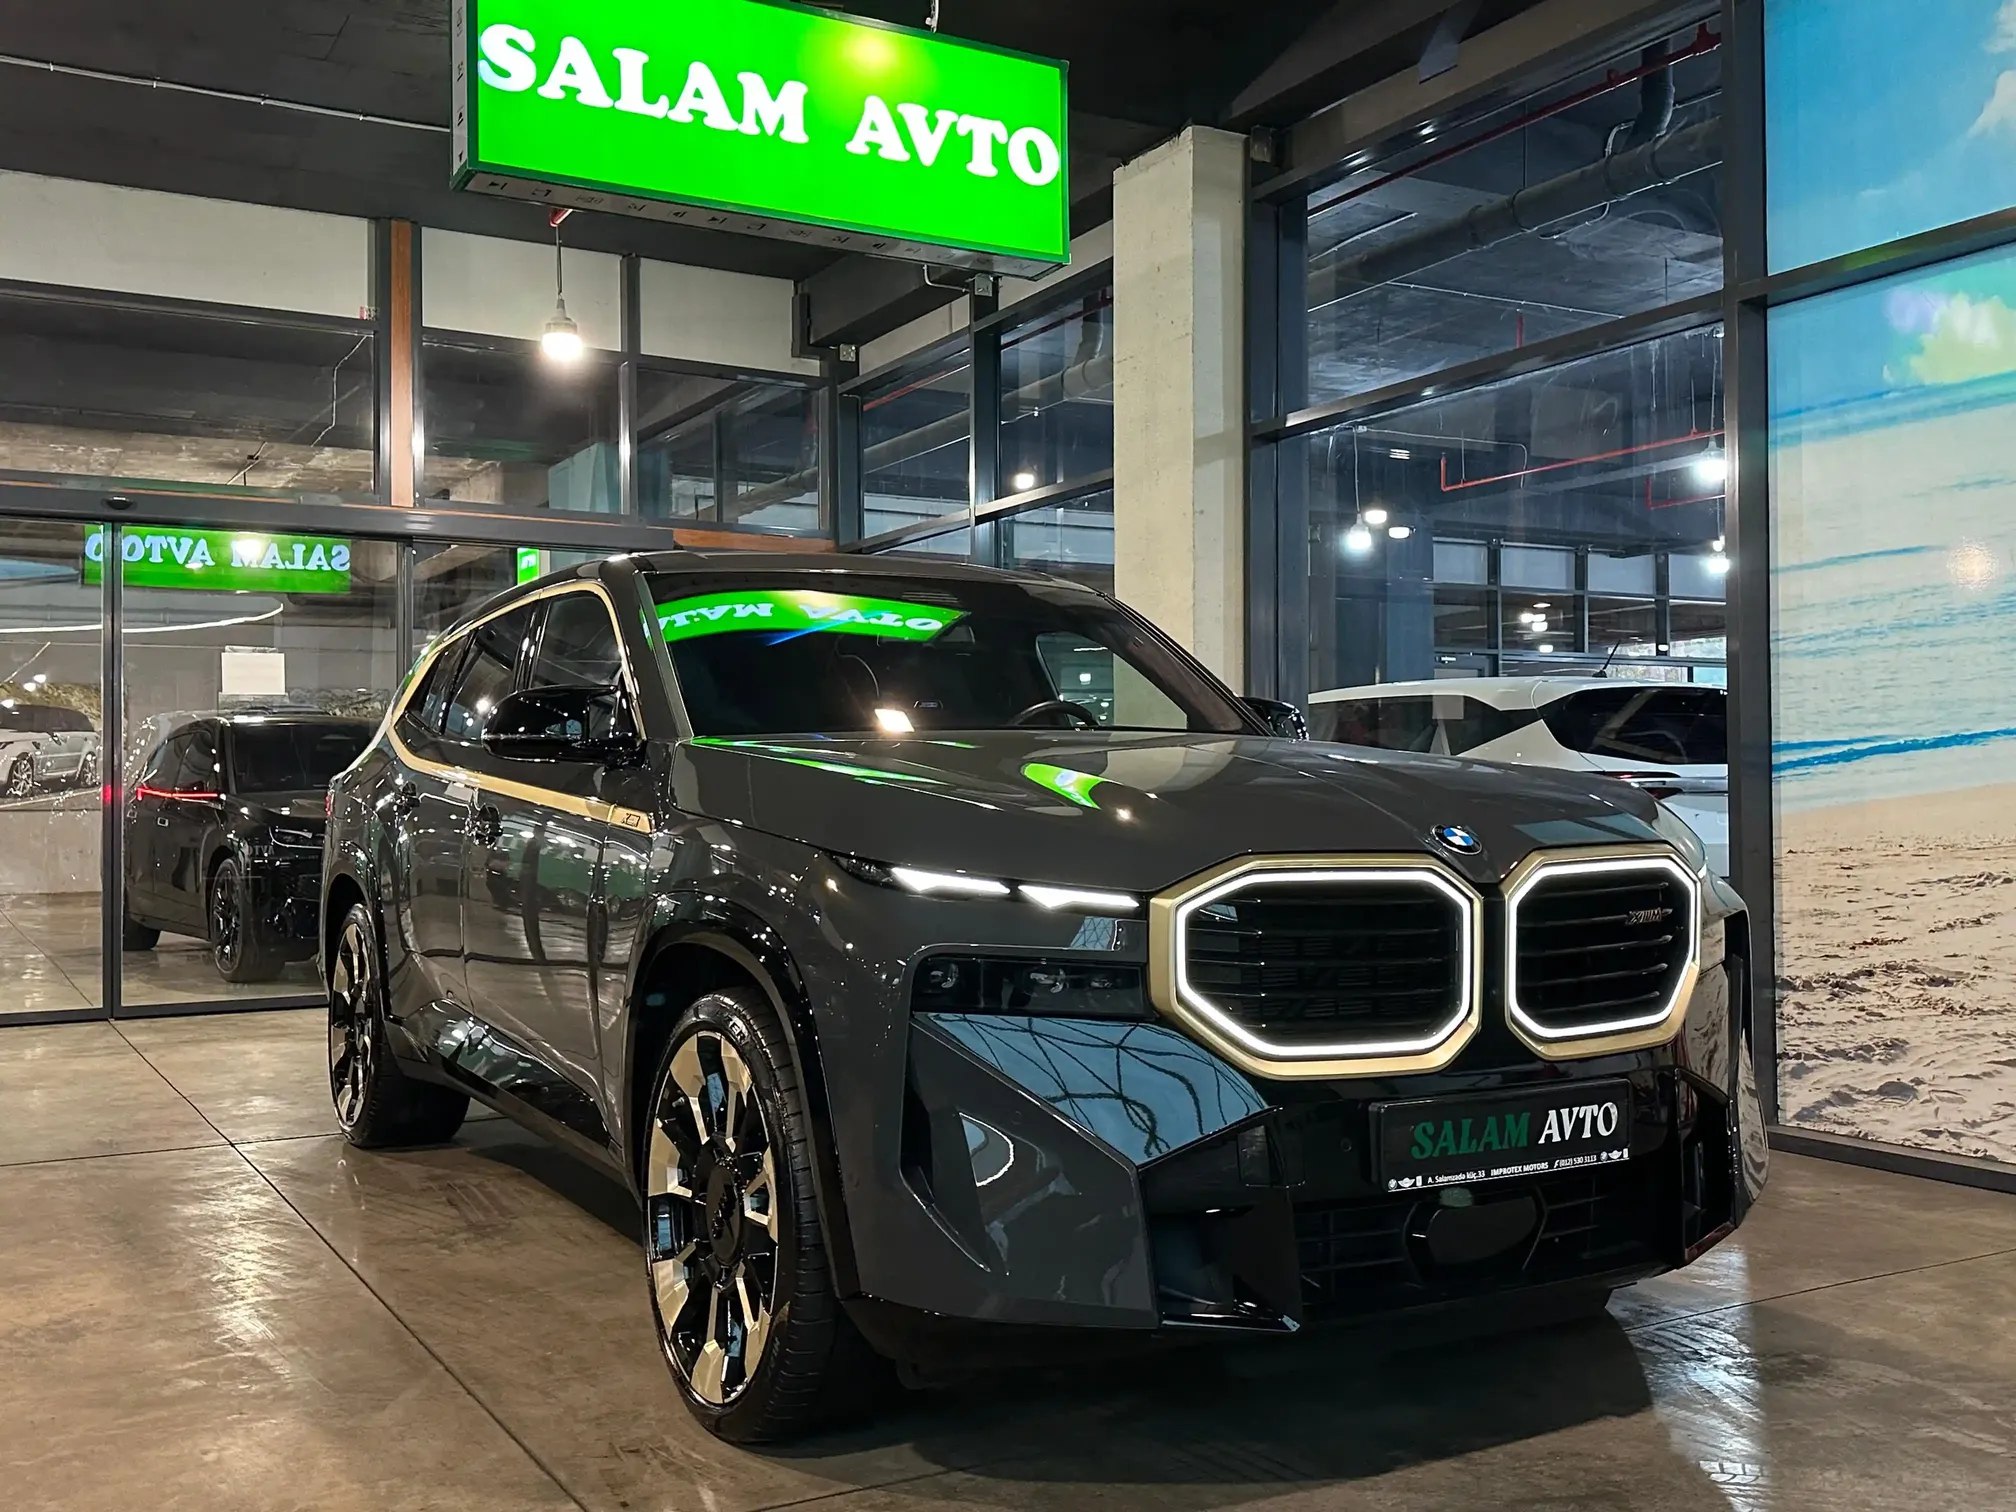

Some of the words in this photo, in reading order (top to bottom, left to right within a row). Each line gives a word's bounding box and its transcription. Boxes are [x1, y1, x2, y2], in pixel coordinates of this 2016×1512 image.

[478, 23, 809, 144] SALAM
[846, 95, 1060, 186] AVTO
[1411, 1113, 1530, 1159] SALAM
[1538, 1101, 1619, 1145] AVTO
[1427, 1176, 1434, 1184] A.
[1491, 1166, 1522, 1176] IMPROTEX
[1523, 1161, 1549, 1172] MOTORS
[1573, 1156, 1584, 1165] 530
